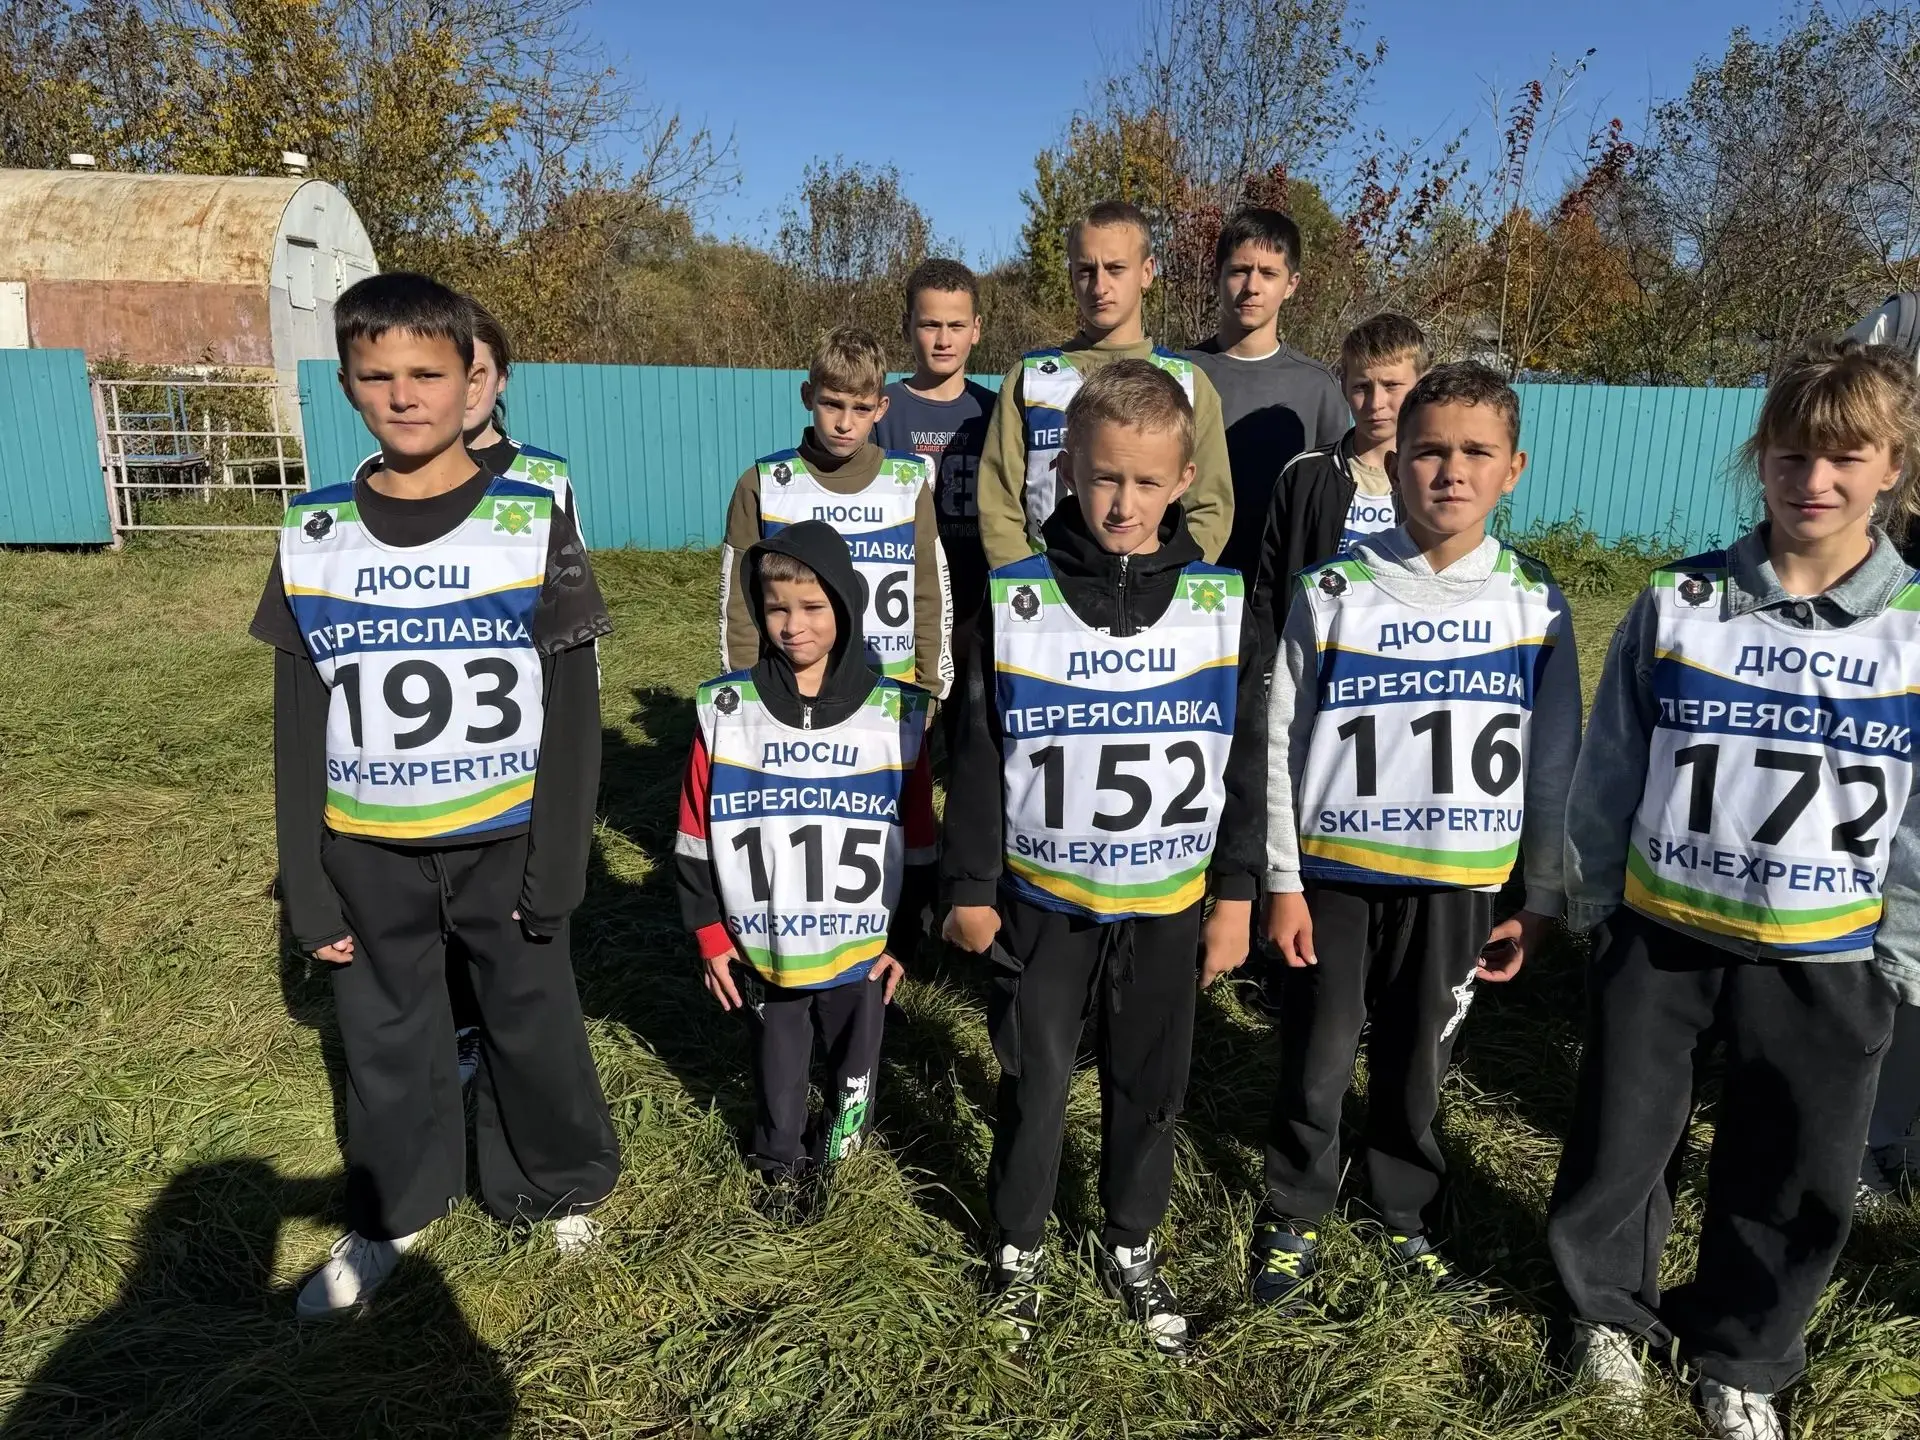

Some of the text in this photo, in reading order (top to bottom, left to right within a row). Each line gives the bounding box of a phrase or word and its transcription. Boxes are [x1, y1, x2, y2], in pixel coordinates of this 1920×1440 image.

[811, 506, 883, 523] ДЮСШ
[1345, 506, 1397, 525] ДЮС
[355, 565, 470, 597] ДЮСШ
[309, 618, 531, 655] ПЕРЕЯСЛАВКА
[1377, 619, 1491, 650] ДЮСШ
[1066, 648, 1176, 681] ДЮСШ
[1735, 645, 1879, 688] ДЮСШ
[1327, 669, 1524, 703] ЕРЕЯСЛАВК
[333, 657, 522, 750] 193
[1005, 700, 1223, 733] ПЕРЕЯСЛАВКА
[1659, 698, 1911, 754] ПЕРЕЯСЛАВК
[762, 741, 859, 768] ДЮСШ
[1338, 709, 1522, 797] 116
[1029, 740, 1209, 832] 152
[1674, 743, 1889, 858] 172
[710, 787, 900, 821] ПЕРЕЯСЛАВКА
[1319, 806, 1523, 833] SKI-EXPERT.RU
[731, 824, 883, 904] 115
[1016, 831, 1212, 867] SKI-EXPERT.RU
[1647, 837, 1881, 894] SKI-EXPERT.R
[729, 913, 887, 937] SKI-EXPERT.RU
